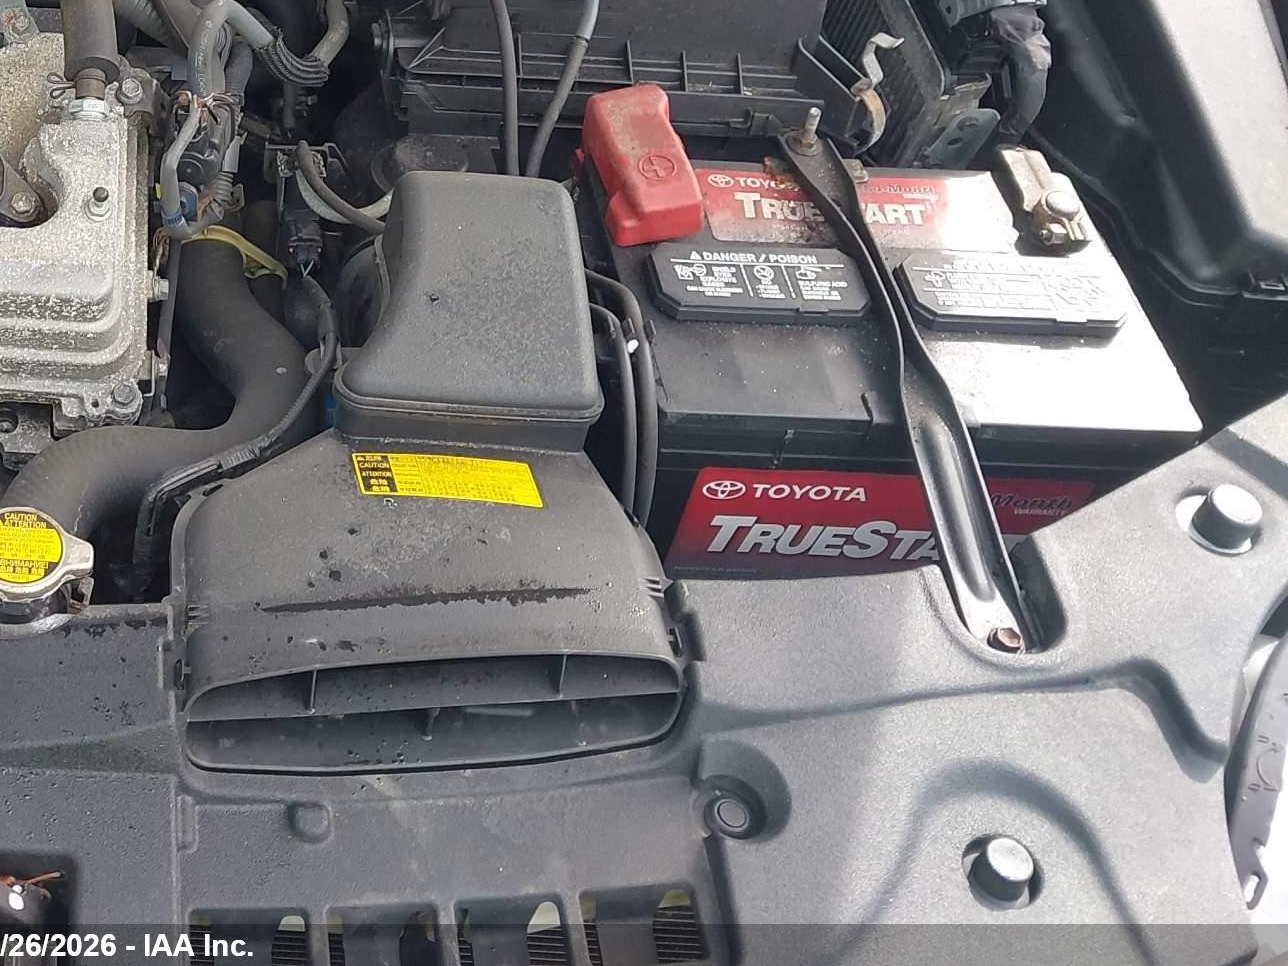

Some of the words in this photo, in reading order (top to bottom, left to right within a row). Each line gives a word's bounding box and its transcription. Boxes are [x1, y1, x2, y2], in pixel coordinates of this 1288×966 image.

[702, 251, 757, 263] DANGER
[768, 253, 818, 265] POISON
[752, 483, 868, 502] TOYOTA
[4, 513, 37, 522] CAUTION
[4, 521, 47, 529] ATTENTION
